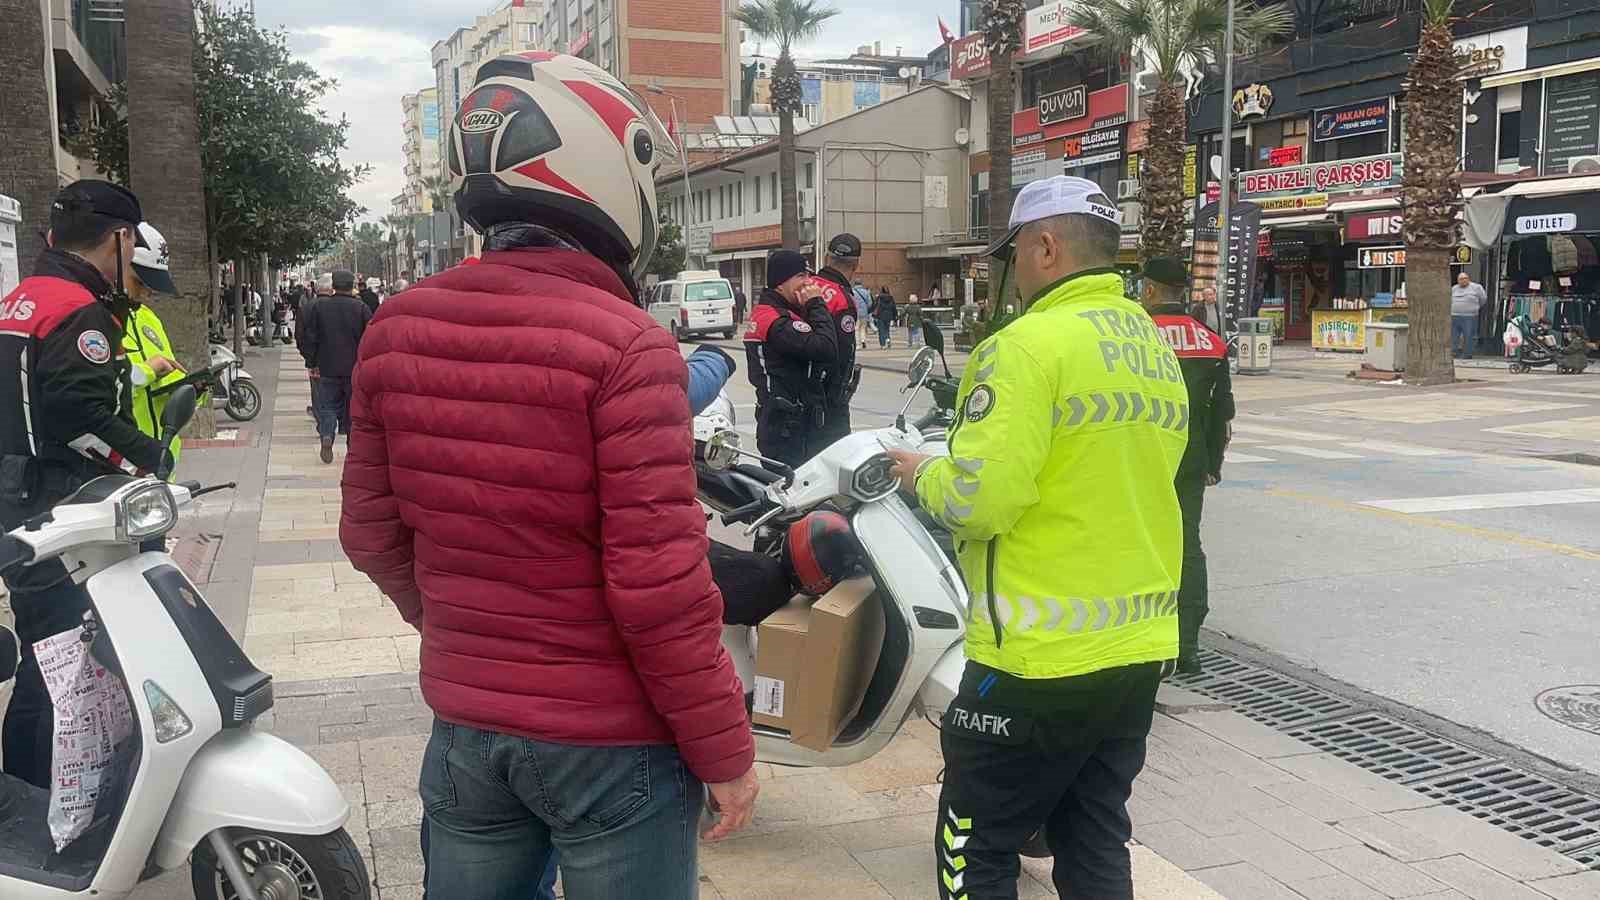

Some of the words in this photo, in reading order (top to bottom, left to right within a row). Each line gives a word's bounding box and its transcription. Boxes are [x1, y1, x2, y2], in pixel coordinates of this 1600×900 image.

[1081, 129, 1119, 145] BİLGİSAYAR
[1245, 167, 1311, 193] DENİZLİ
[1314, 159, 1392, 191] ÇARŞISI
[1525, 217, 1564, 230] OUTLET
[1098, 340, 1183, 383] POLİS
[951, 706, 1013, 737] TRAFİK
